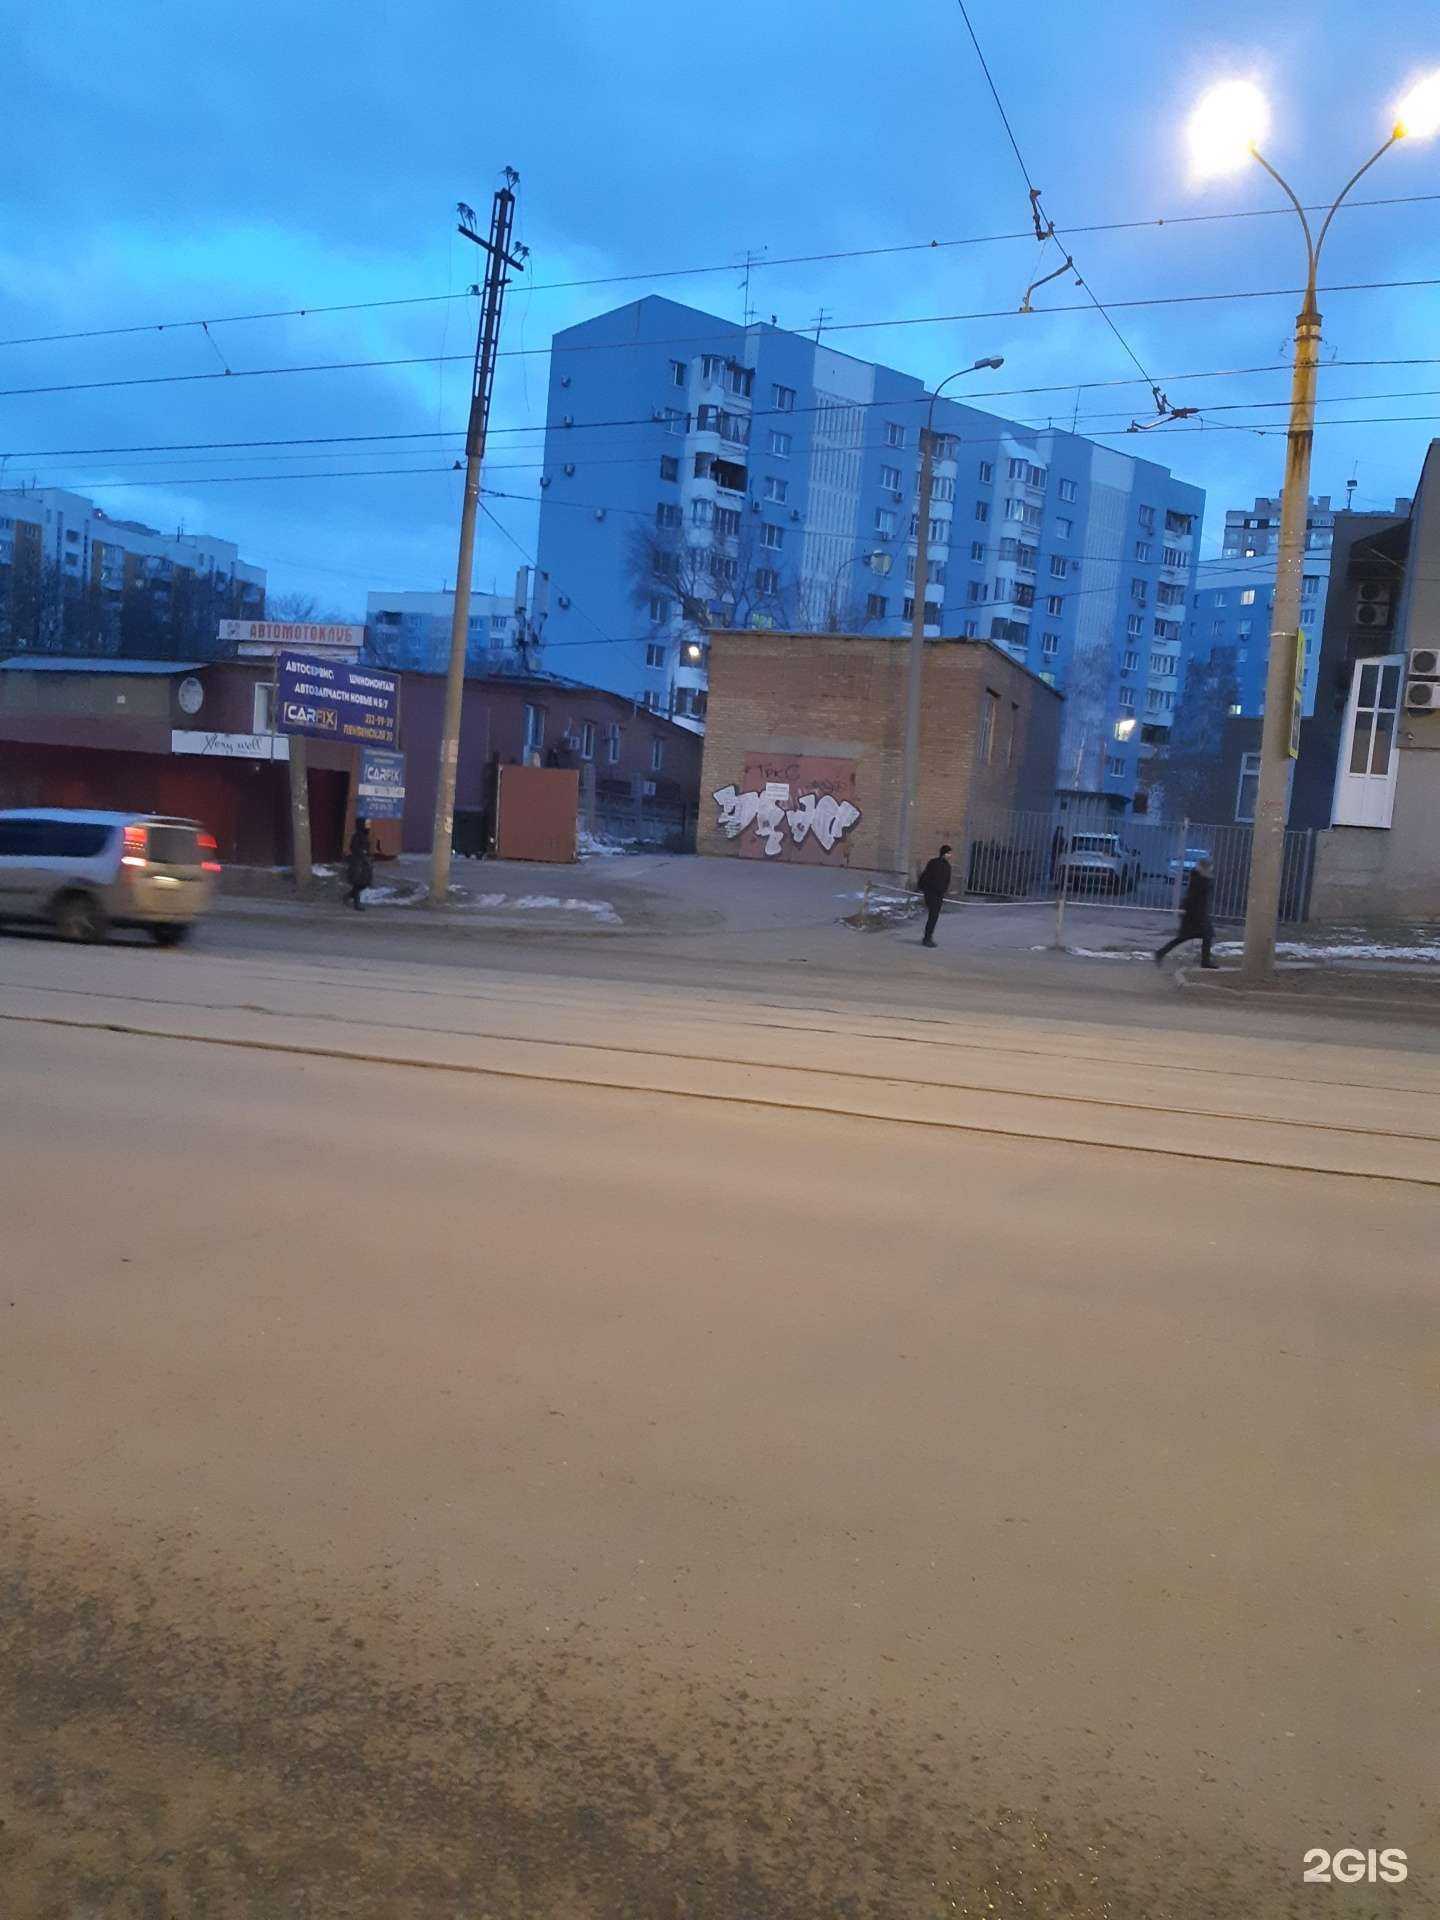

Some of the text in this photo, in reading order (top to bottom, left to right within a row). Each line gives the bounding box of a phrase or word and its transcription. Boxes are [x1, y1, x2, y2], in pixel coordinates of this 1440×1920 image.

[250, 623, 354, 643] АВТОМОТОКЛУБ
[294, 682, 349, 701] АВТОЗАПЧАСТИ
[287, 705, 335, 725] CARFIX
